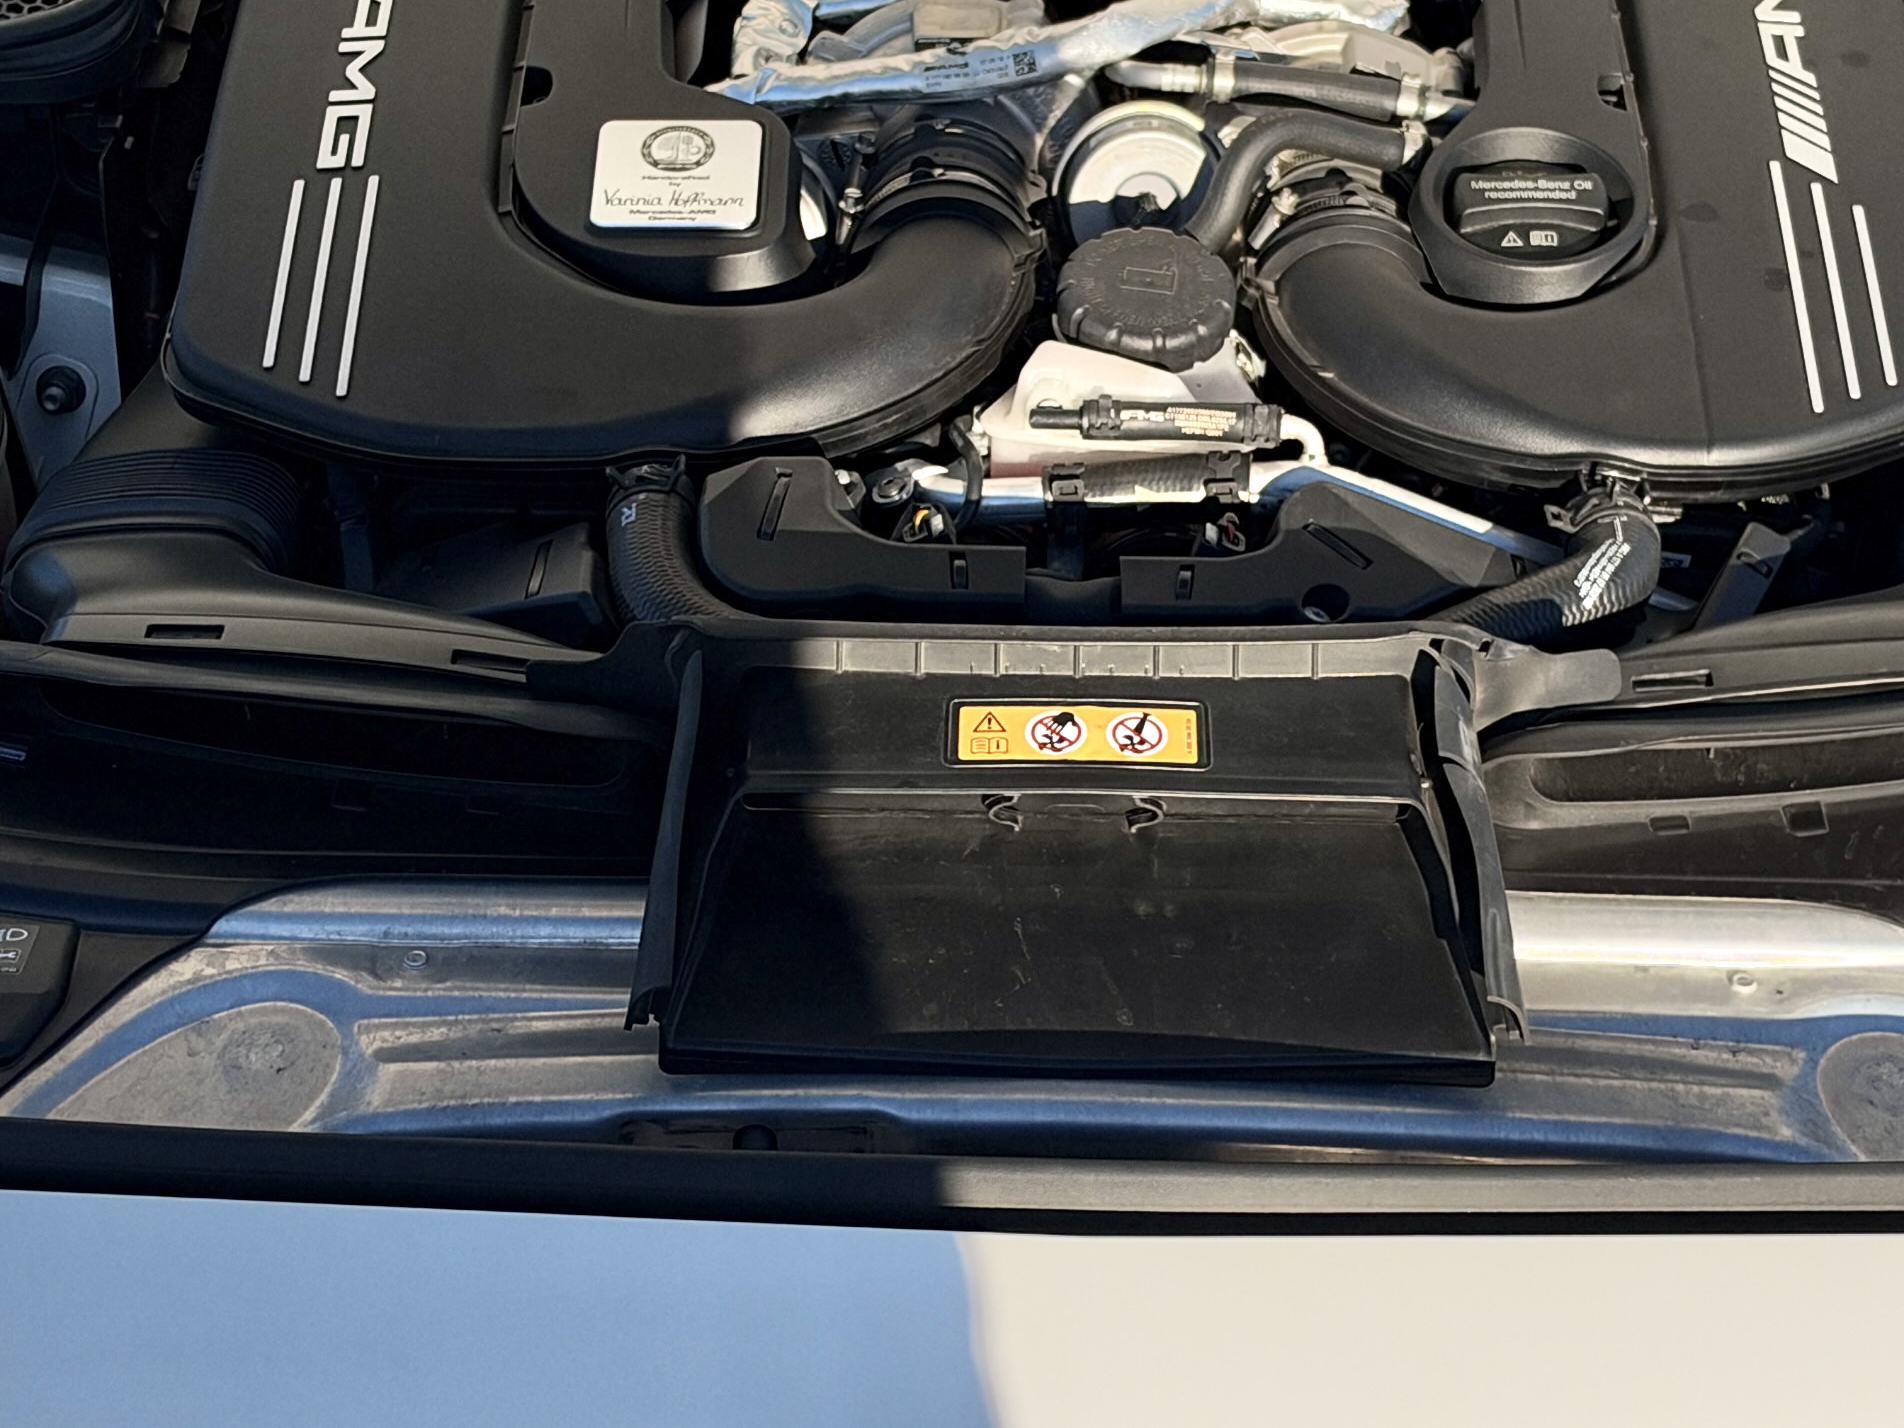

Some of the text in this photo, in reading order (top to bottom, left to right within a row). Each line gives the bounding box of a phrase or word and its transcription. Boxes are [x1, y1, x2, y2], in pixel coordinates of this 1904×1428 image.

[1470, 179, 1593, 190] Mercedes-Benz Oil
[1484, 189, 1577, 200] recommended
